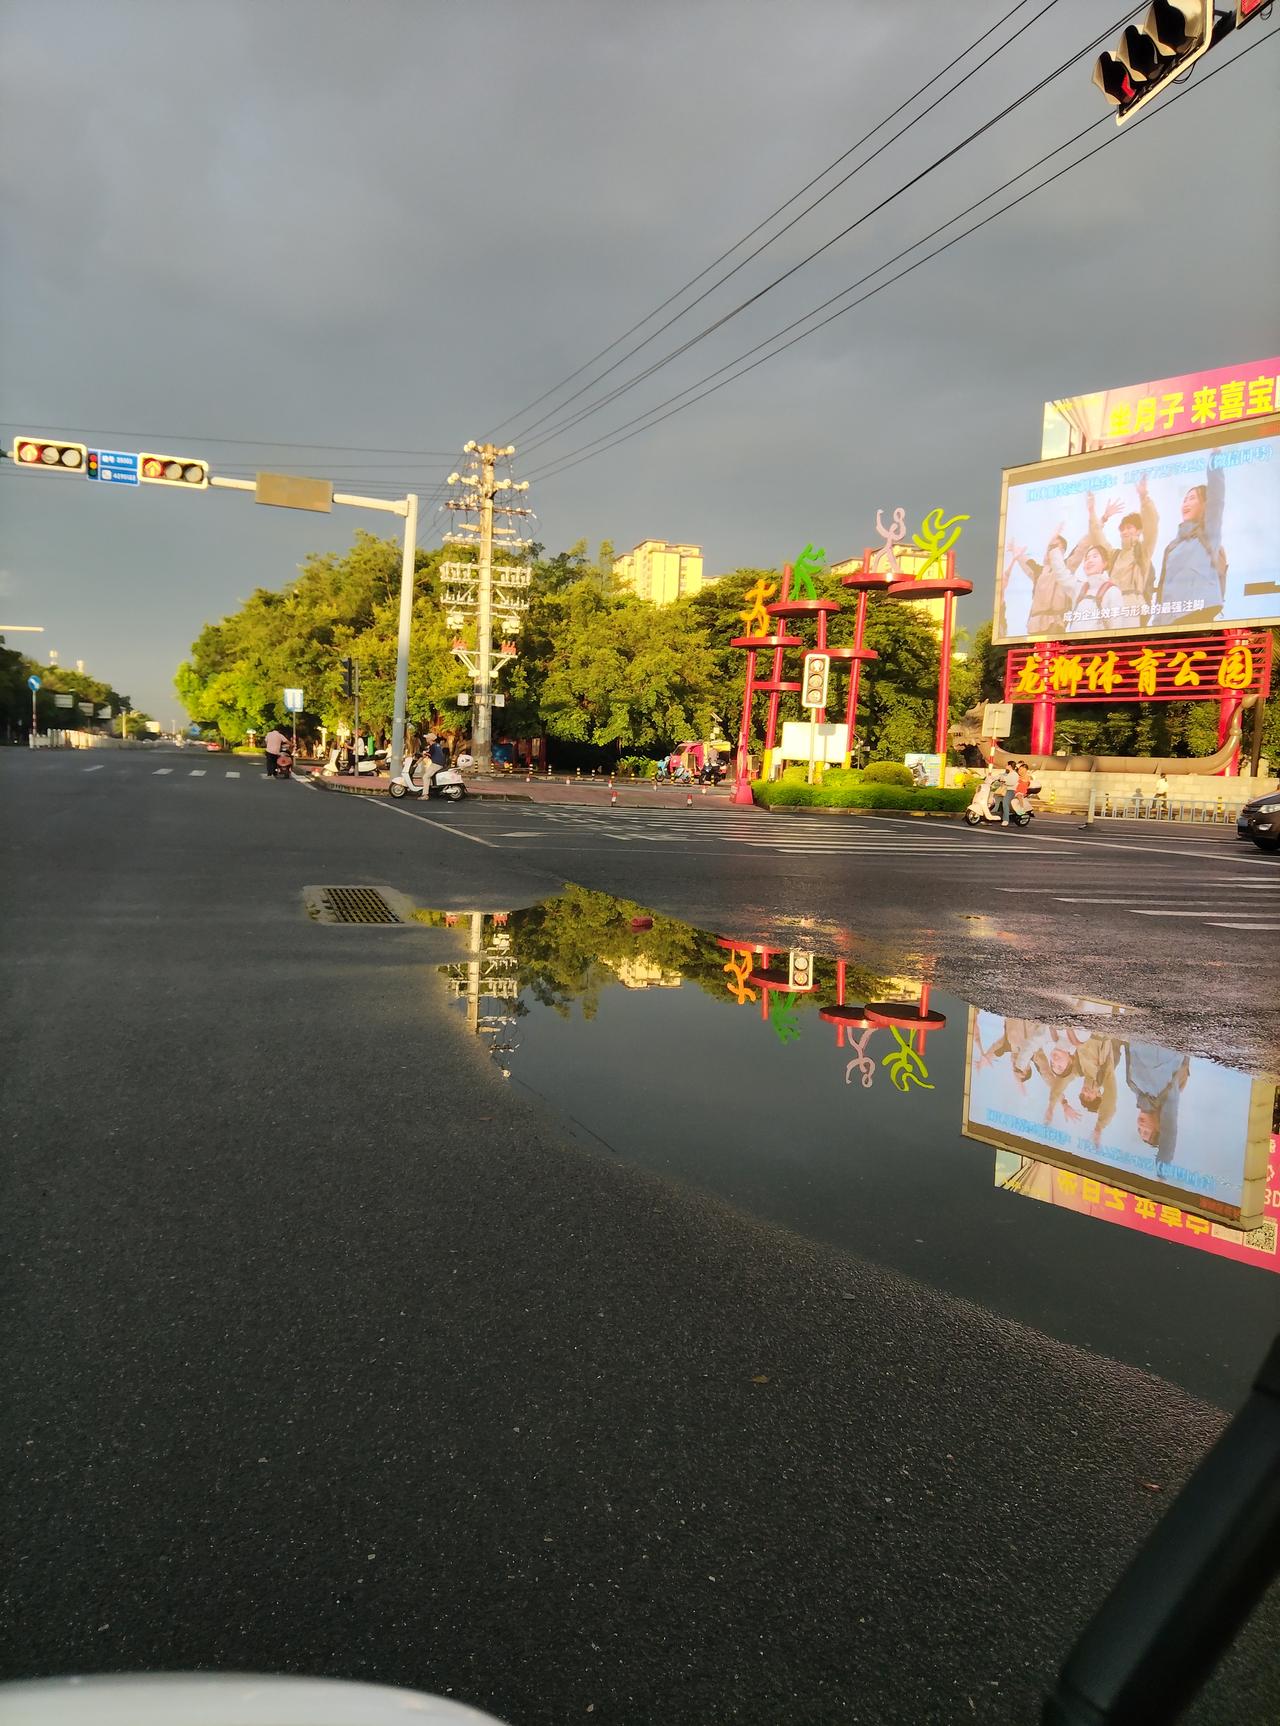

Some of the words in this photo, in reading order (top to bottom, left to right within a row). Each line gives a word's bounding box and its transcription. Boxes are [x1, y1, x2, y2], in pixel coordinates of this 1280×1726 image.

[1107, 391, 1185, 438] 坐月子
[1190, 374, 1275, 425] 来喜宝
[1062, 599, 1205, 623] 成为企业效率与形象的最强注脚
[1016, 646, 1253, 697] 龙狮体育公园
